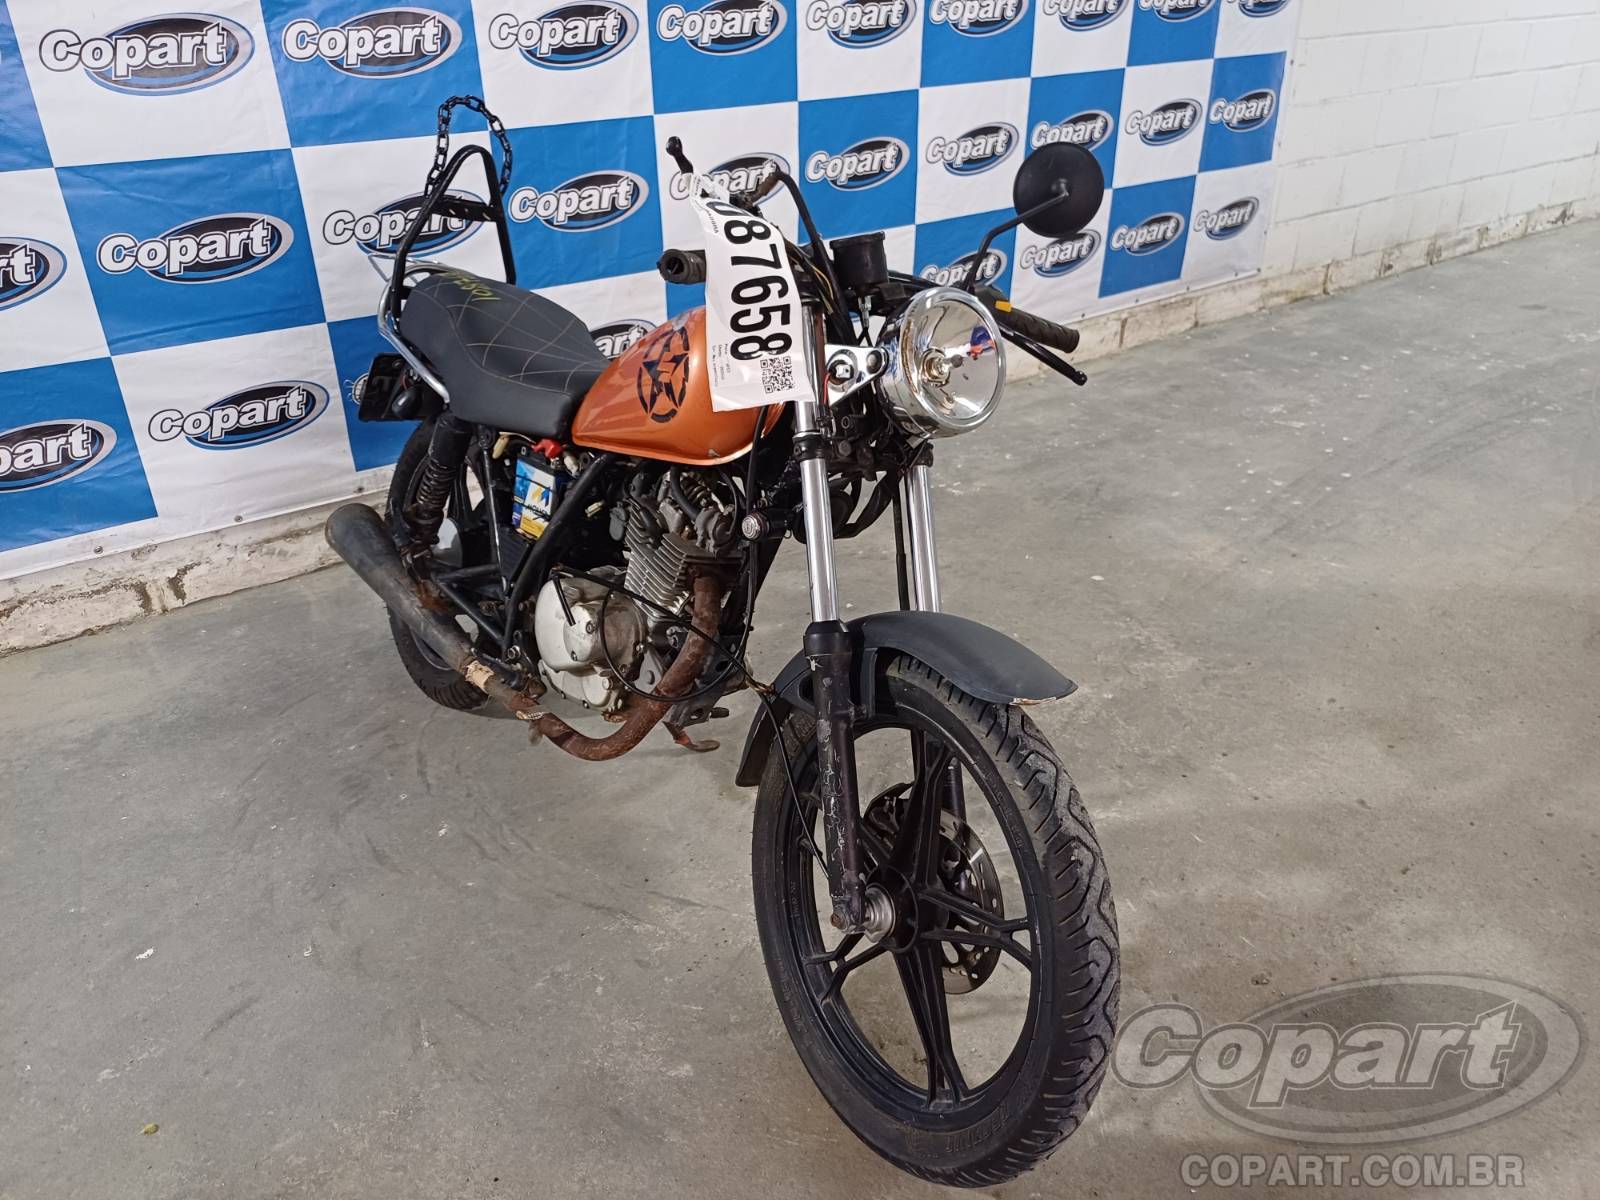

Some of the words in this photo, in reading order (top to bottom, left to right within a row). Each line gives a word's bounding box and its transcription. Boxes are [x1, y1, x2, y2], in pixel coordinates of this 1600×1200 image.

[489, 9, 622, 57] Copart
[658, 3, 774, 47] Copart
[806, 0, 905, 37] Copart
[930, 0, 1017, 28] Copart
[39, 22, 227, 80] Copart
[283, 15, 442, 67] Copart
[1125, 105, 1194, 140] Copart
[1209, 94, 1273, 126] Copart
[925, 128, 1012, 169] Copart
[1030, 115, 1106, 150] Copart
[805, 143, 900, 185] Copart
[509, 177, 634, 225] Copart
[1193, 202, 1251, 235] Copart
[97, 217, 272, 276] Copart
[1020, 235, 1092, 272] Copart
[1111, 218, 1176, 253] Copart
[148, 384, 306, 442] Copart
